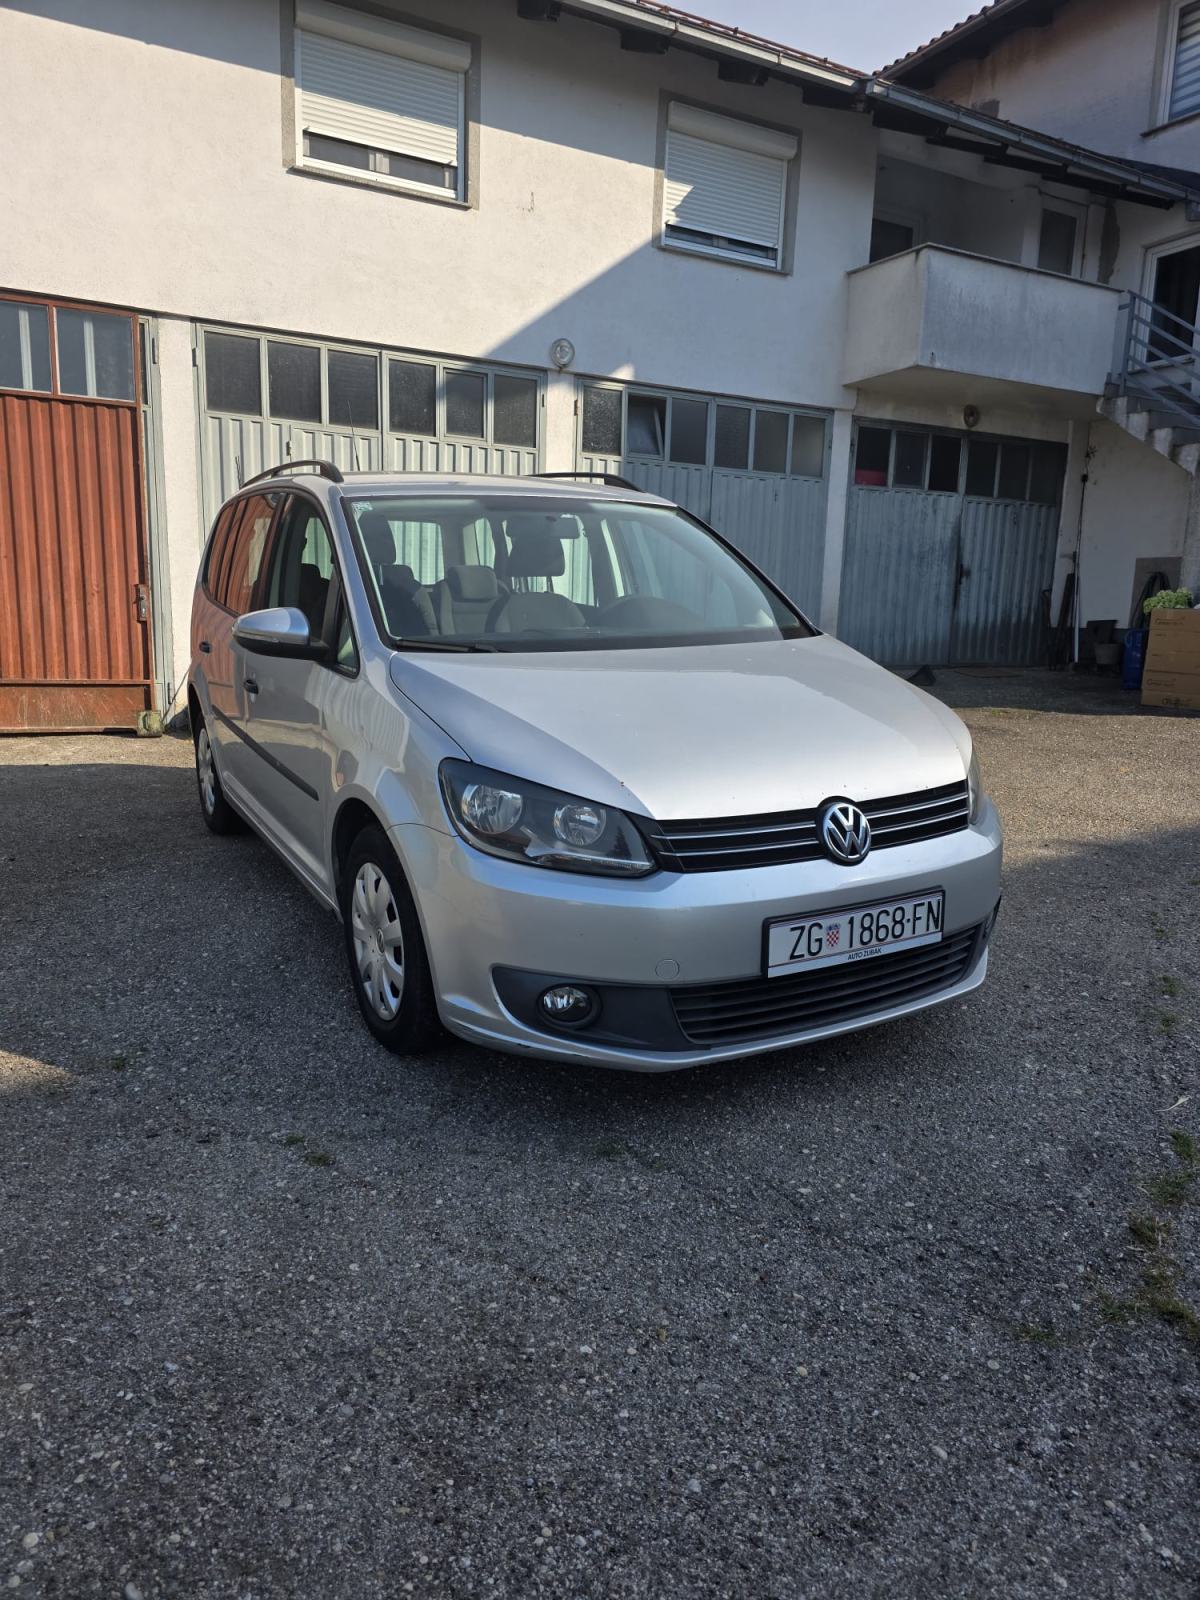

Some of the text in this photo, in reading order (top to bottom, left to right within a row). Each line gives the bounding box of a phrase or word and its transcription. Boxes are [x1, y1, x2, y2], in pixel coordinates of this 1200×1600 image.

[823, 802, 871, 859] VW
[789, 922, 823, 960] ZG
[847, 947, 882, 961] AUTO ZUBAK
